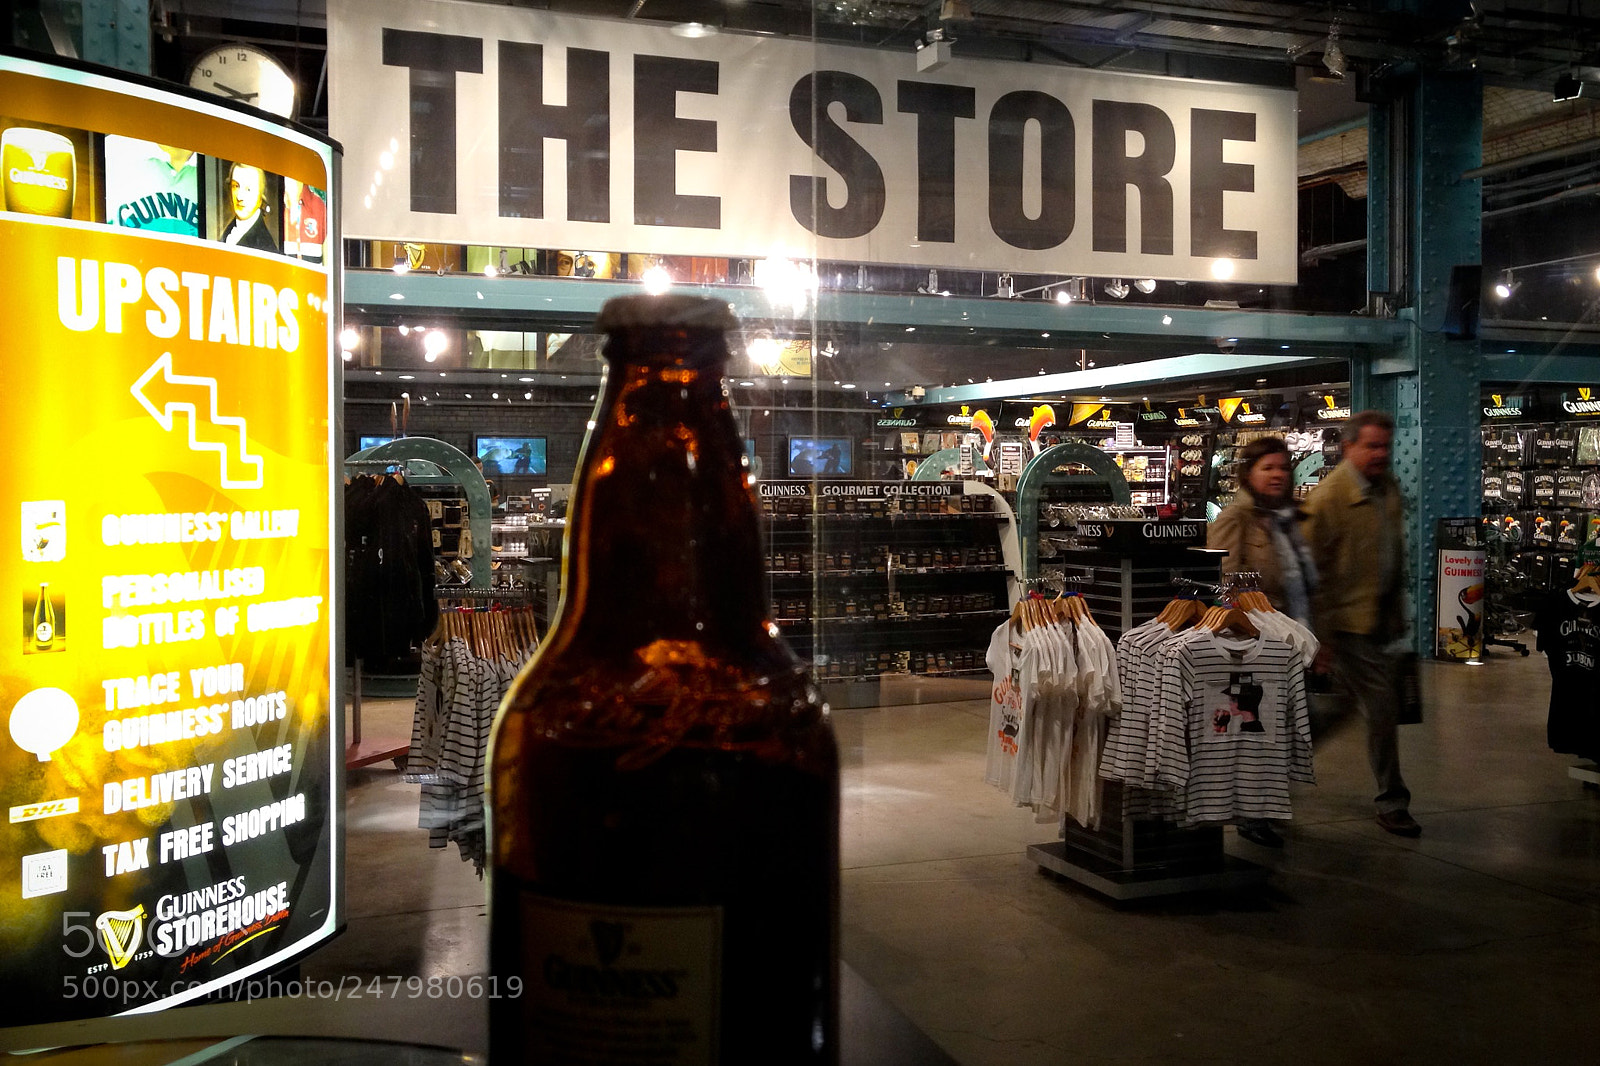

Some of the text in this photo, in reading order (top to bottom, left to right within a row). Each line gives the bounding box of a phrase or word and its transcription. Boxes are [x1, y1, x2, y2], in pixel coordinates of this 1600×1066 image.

[218, 55, 226, 64] 11
[236, 53, 247, 62] 12
[201, 69, 212, 78] 10
[382, 28, 1258, 260] THE STORE
[57, 256, 299, 352] UPSTAIRS
[1484, 408, 1522, 417] GUINNESS
[759, 483, 951, 496] GUINNESS GOURMET COLLECTION
[1142, 522, 1197, 538] GUINNESS
[1445, 555, 1471, 566] Lovely
[1444, 566, 1483, 577] GUINNESS
[102, 566, 265, 608] PERSONALISED
[103, 609, 205, 649] BOTTLES
[215, 607, 239, 637] OF
[102, 663, 244, 711] TRACE YOUR
[231, 691, 287, 730] ROOTS
[104, 743, 292, 815] DELIVERY SERVICE
[22, 803, 67, 818] DHL
[102, 793, 305, 878] TAX FREE SHOPPING
[156, 875, 246, 921] GUINNESS
[134, 949, 154, 962] 1759
